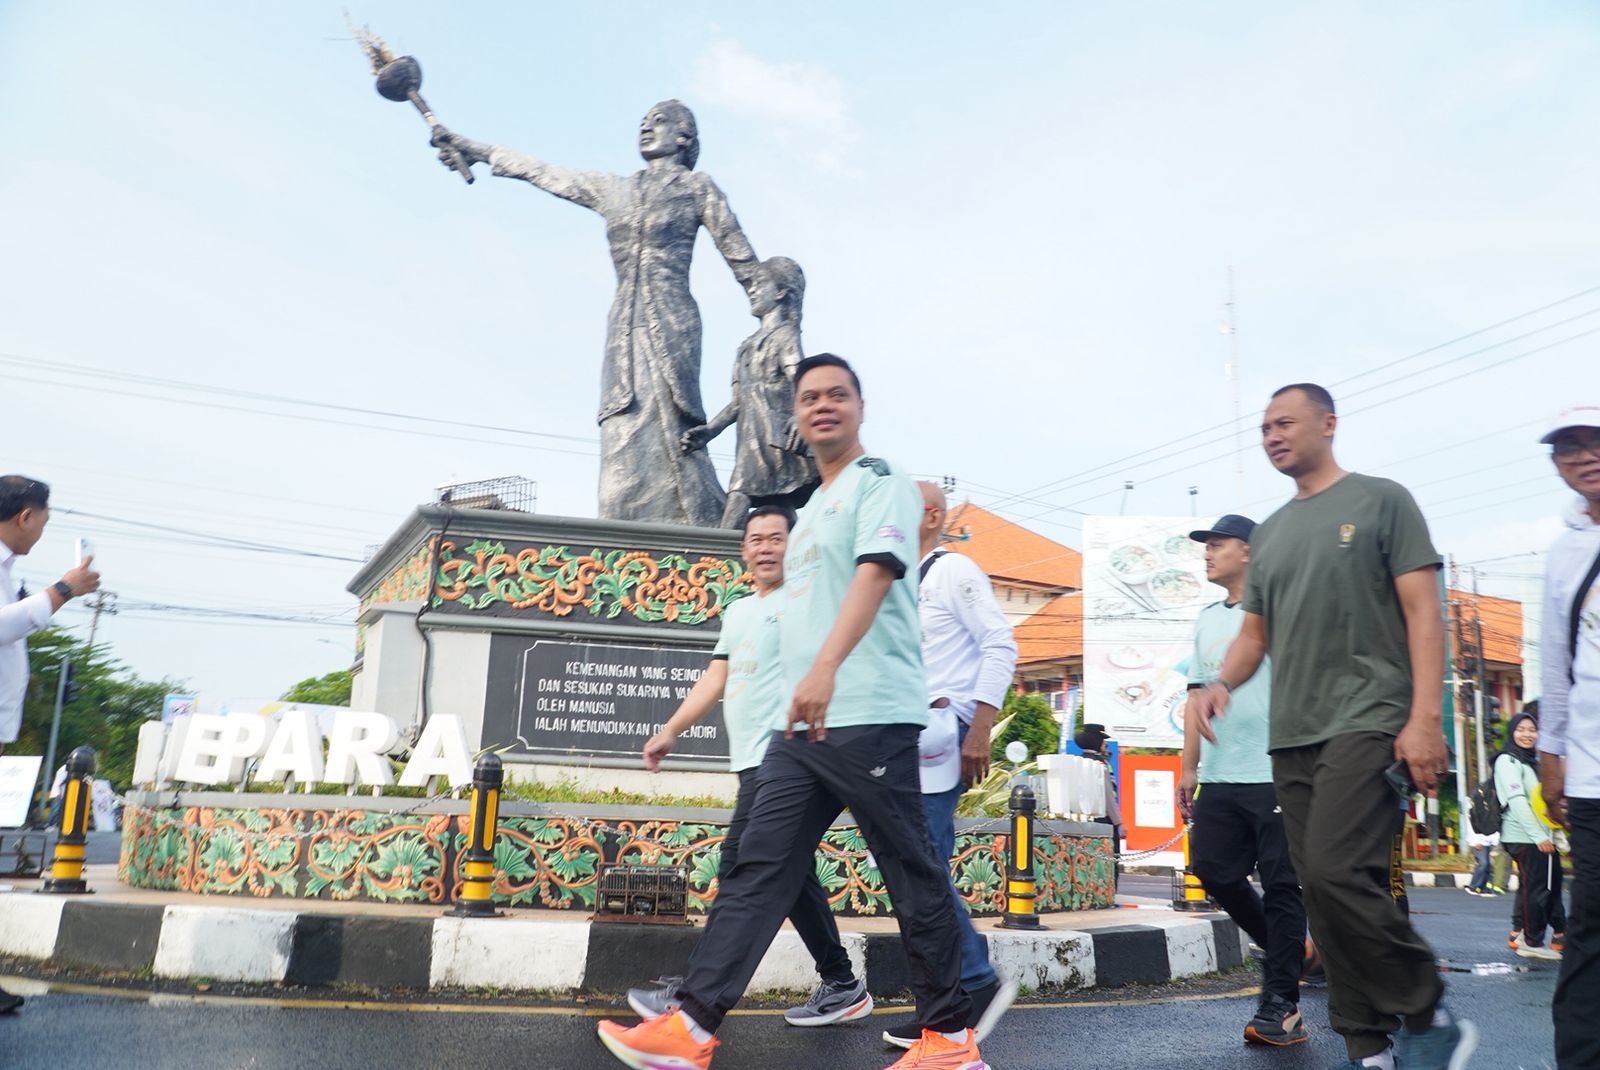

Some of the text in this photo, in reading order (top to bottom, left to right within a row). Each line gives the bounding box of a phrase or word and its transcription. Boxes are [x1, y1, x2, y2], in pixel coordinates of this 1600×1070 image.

[565, 661, 637, 678] KEMENANGAN
[641, 666, 667, 680] YANG
[538, 678, 561, 693] DAN
[564, 681, 612, 696] SESUKAR
[616, 684, 670, 699] SUKARNYA
[537, 698, 616, 715] OLEH MANUSIA
[535, 717, 567, 731] IALAH
[570, 719, 650, 736] MENUNDUKKAN
